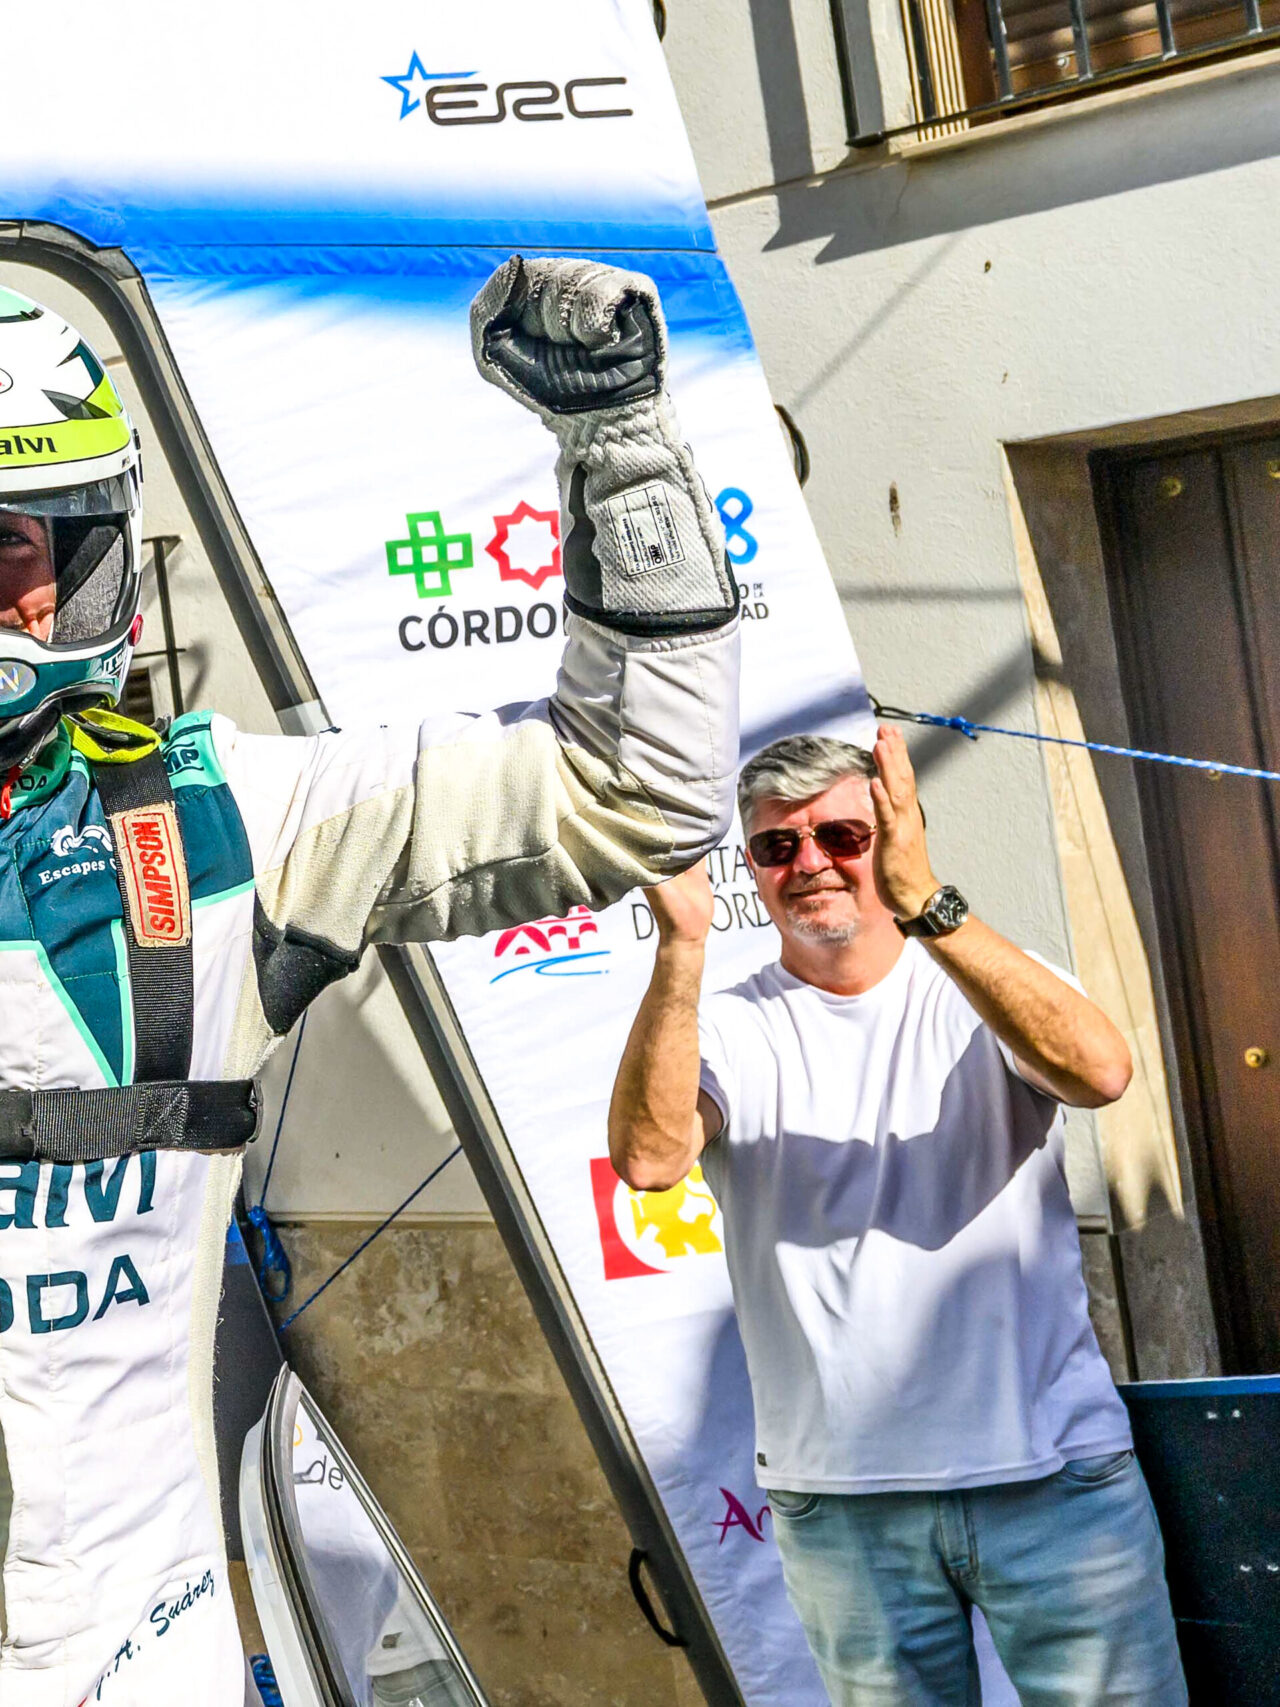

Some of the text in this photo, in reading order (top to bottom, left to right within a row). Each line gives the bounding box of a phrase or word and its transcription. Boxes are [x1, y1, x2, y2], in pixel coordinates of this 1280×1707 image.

[425, 77, 633, 126] ERC
[649, 543, 664, 565] OMP
[398, 604, 568, 652] CÓRDO
[164, 749, 199, 774] MP
[38, 858, 105, 885] Escapes
[131, 821, 176, 933] SIMPSON
[150, 1569, 214, 1637] Suárez
